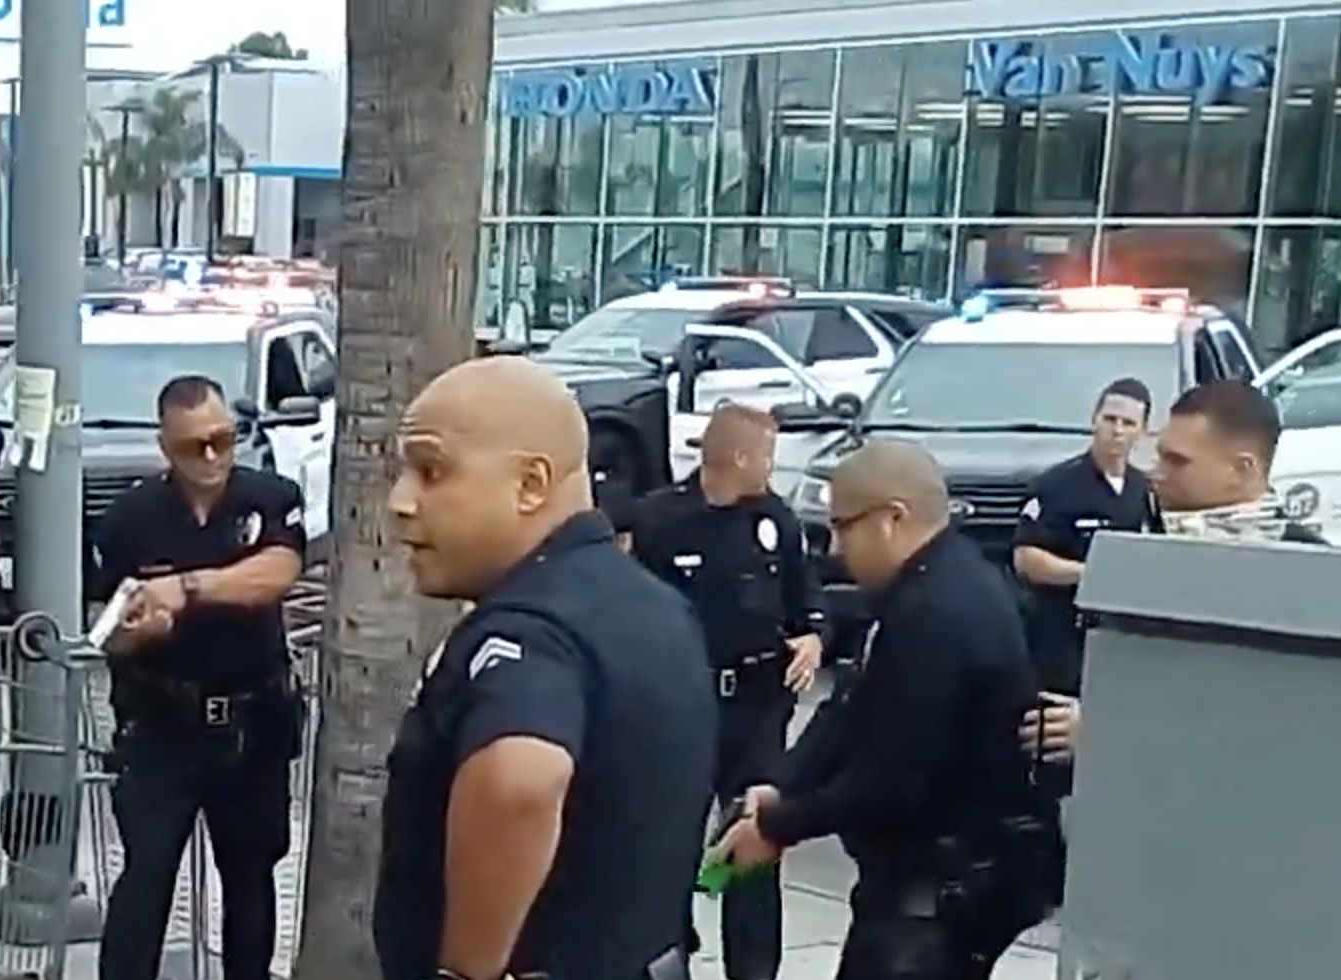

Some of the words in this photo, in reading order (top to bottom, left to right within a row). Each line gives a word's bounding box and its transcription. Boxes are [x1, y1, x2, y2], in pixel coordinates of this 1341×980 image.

[503, 69, 714, 115] HONDA
[971, 40, 1081, 97] Van
[1112, 29, 1266, 106] Nuys
